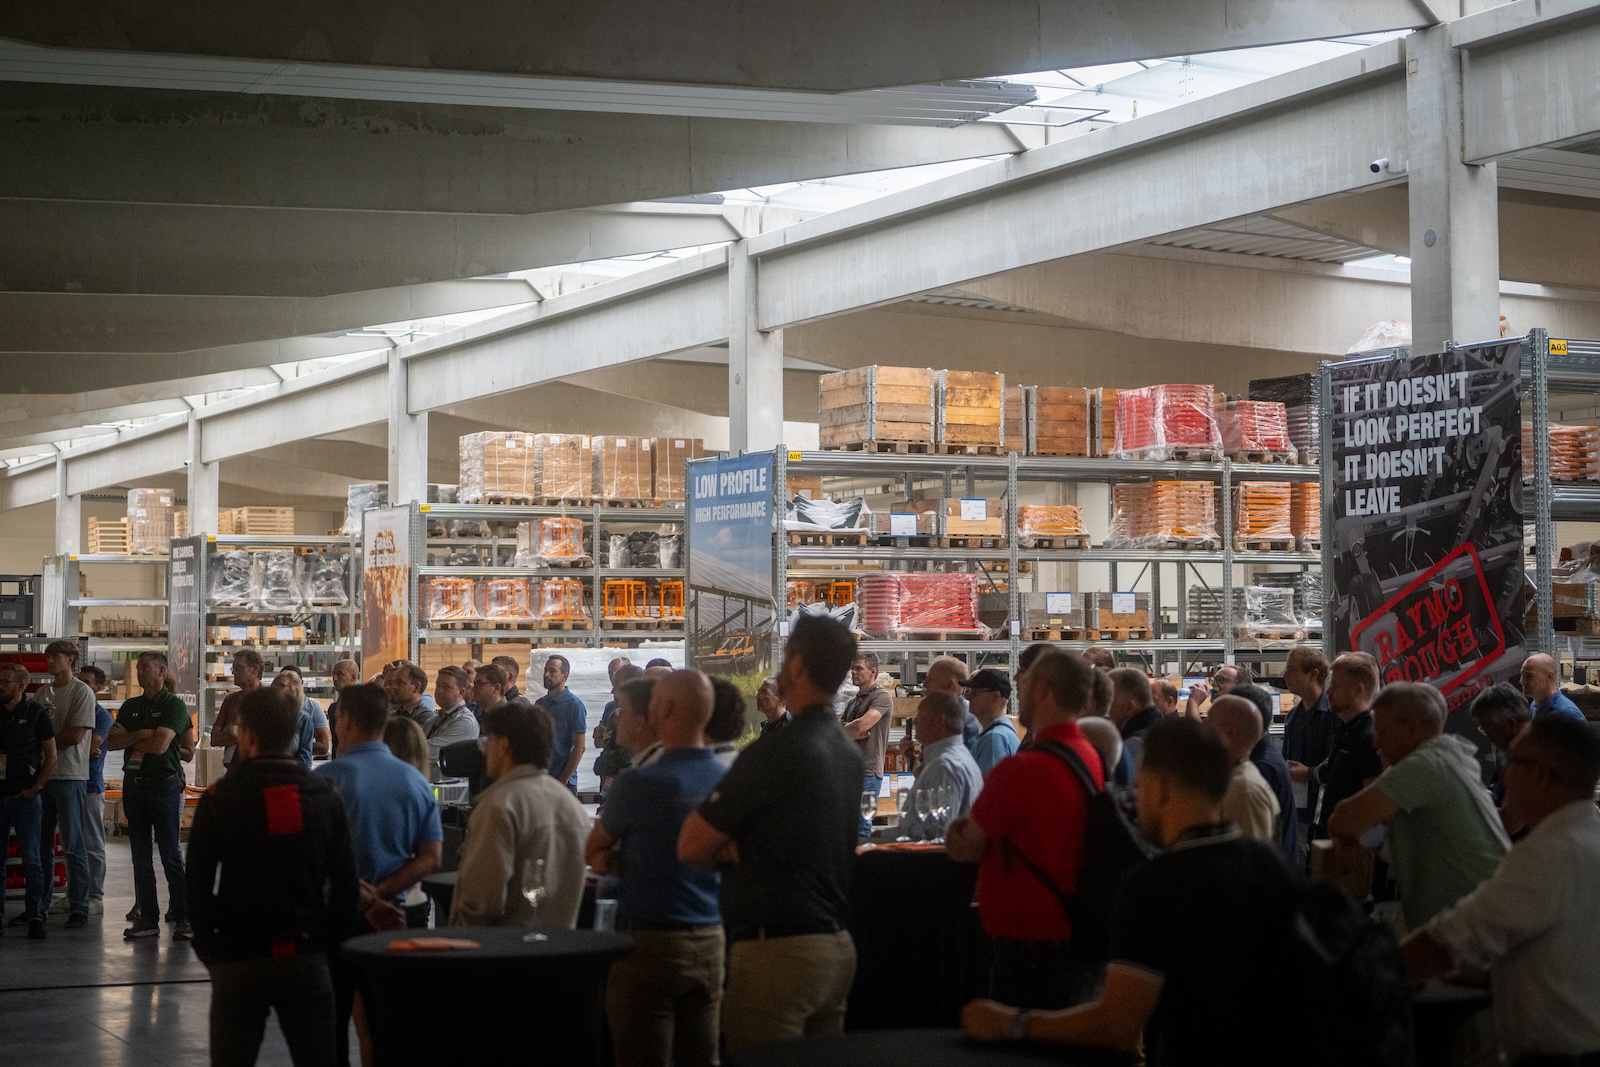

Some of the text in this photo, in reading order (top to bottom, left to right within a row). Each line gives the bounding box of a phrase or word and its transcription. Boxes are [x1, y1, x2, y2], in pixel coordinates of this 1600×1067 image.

[1550, 343, 1567, 352] A03
[1343, 371, 1469, 413] IF IT DOESN'T
[1344, 417, 1391, 448] LOOK
[1396, 406, 1483, 442] PERFECT
[1344, 446, 1446, 482] IT DOESN'T
[695, 467, 767, 499] LOW PROFILE
[695, 501, 766, 523] HIGH PERFORMANCE
[1345, 486, 1401, 516] LEAVE
[1373, 577, 1464, 666] RAYMO
